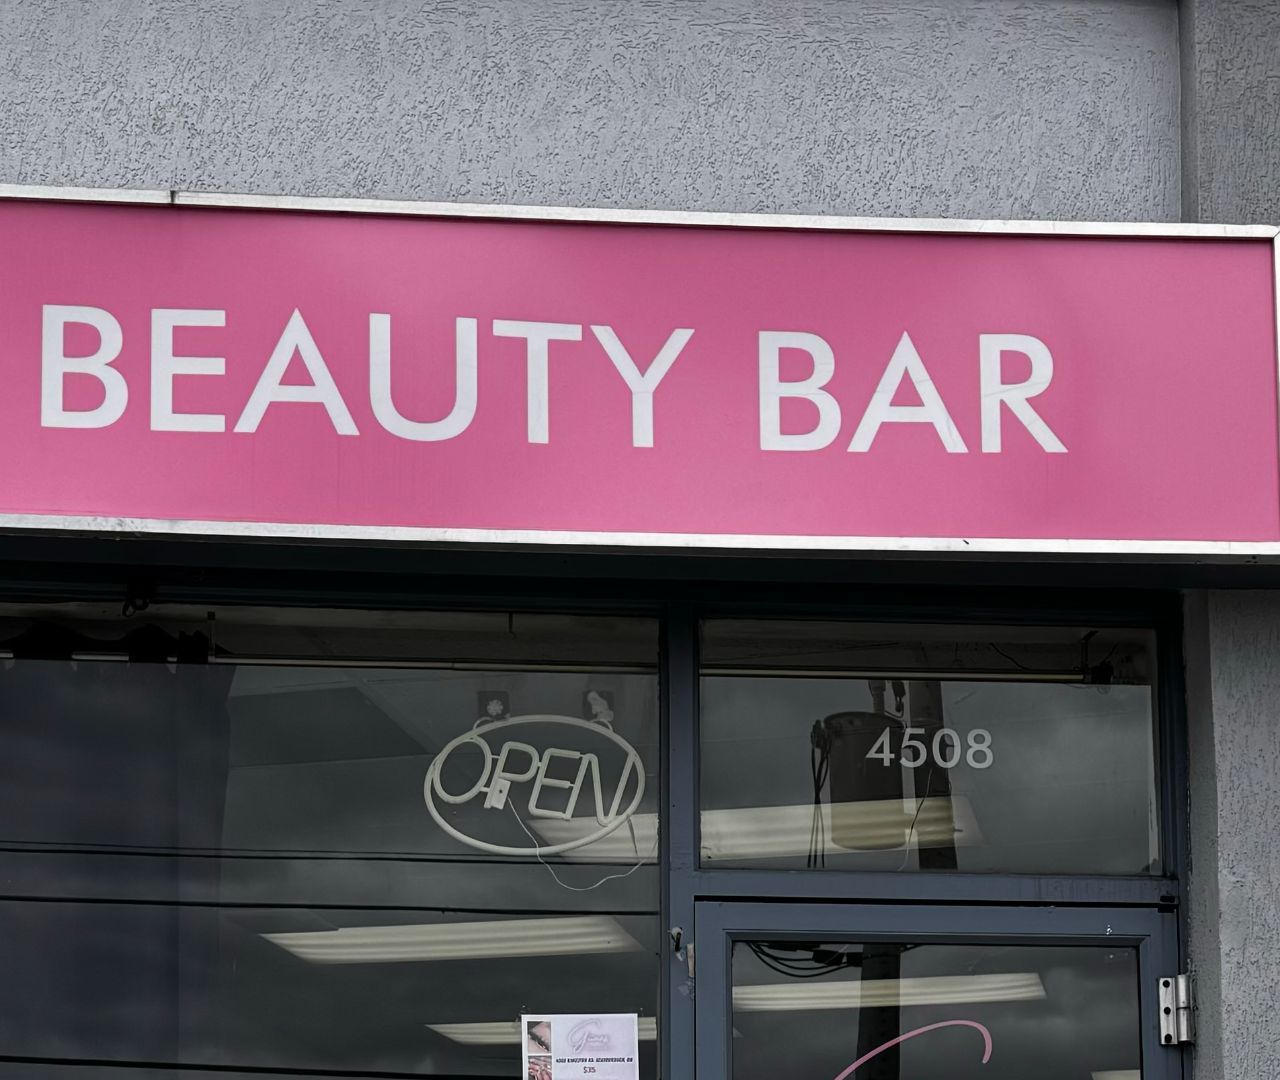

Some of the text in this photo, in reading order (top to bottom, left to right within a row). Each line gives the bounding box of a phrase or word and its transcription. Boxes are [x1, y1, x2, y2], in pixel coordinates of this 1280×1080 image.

[40, 304, 695, 447] BEAUTY
[757, 329, 1069, 454] BAR
[433, 735, 637, 827] OPEN
[865, 726, 995, 769] 4508
